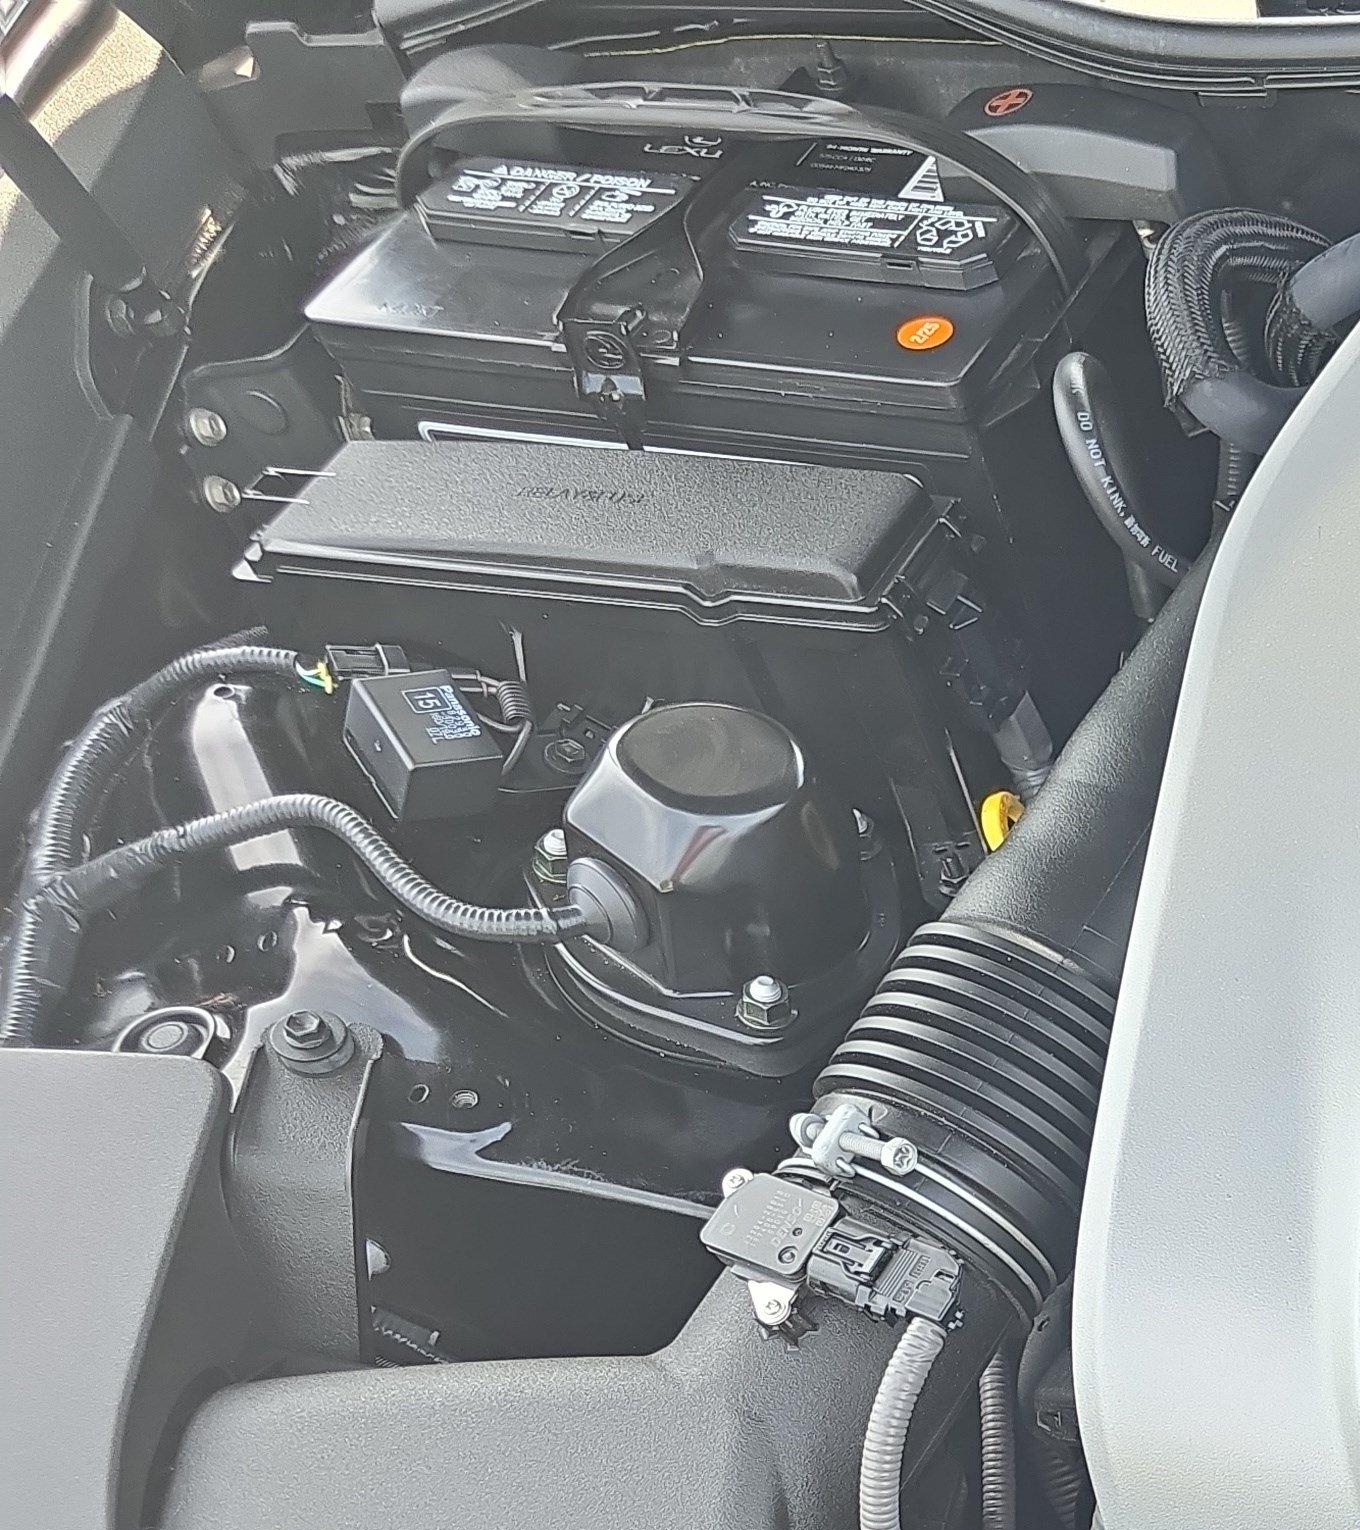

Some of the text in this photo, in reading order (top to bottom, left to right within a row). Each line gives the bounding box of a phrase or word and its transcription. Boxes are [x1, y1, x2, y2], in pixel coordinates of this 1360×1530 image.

[509, 165, 577, 182] DANGER
[589, 173, 652, 188] POISON
[1076, 411, 1094, 432] DO
[1086, 438, 1107, 468] NOT
[1151, 545, 1179, 573] FUEL
[413, 691, 442, 709] 15
[440, 684, 481, 736] Panasonic
